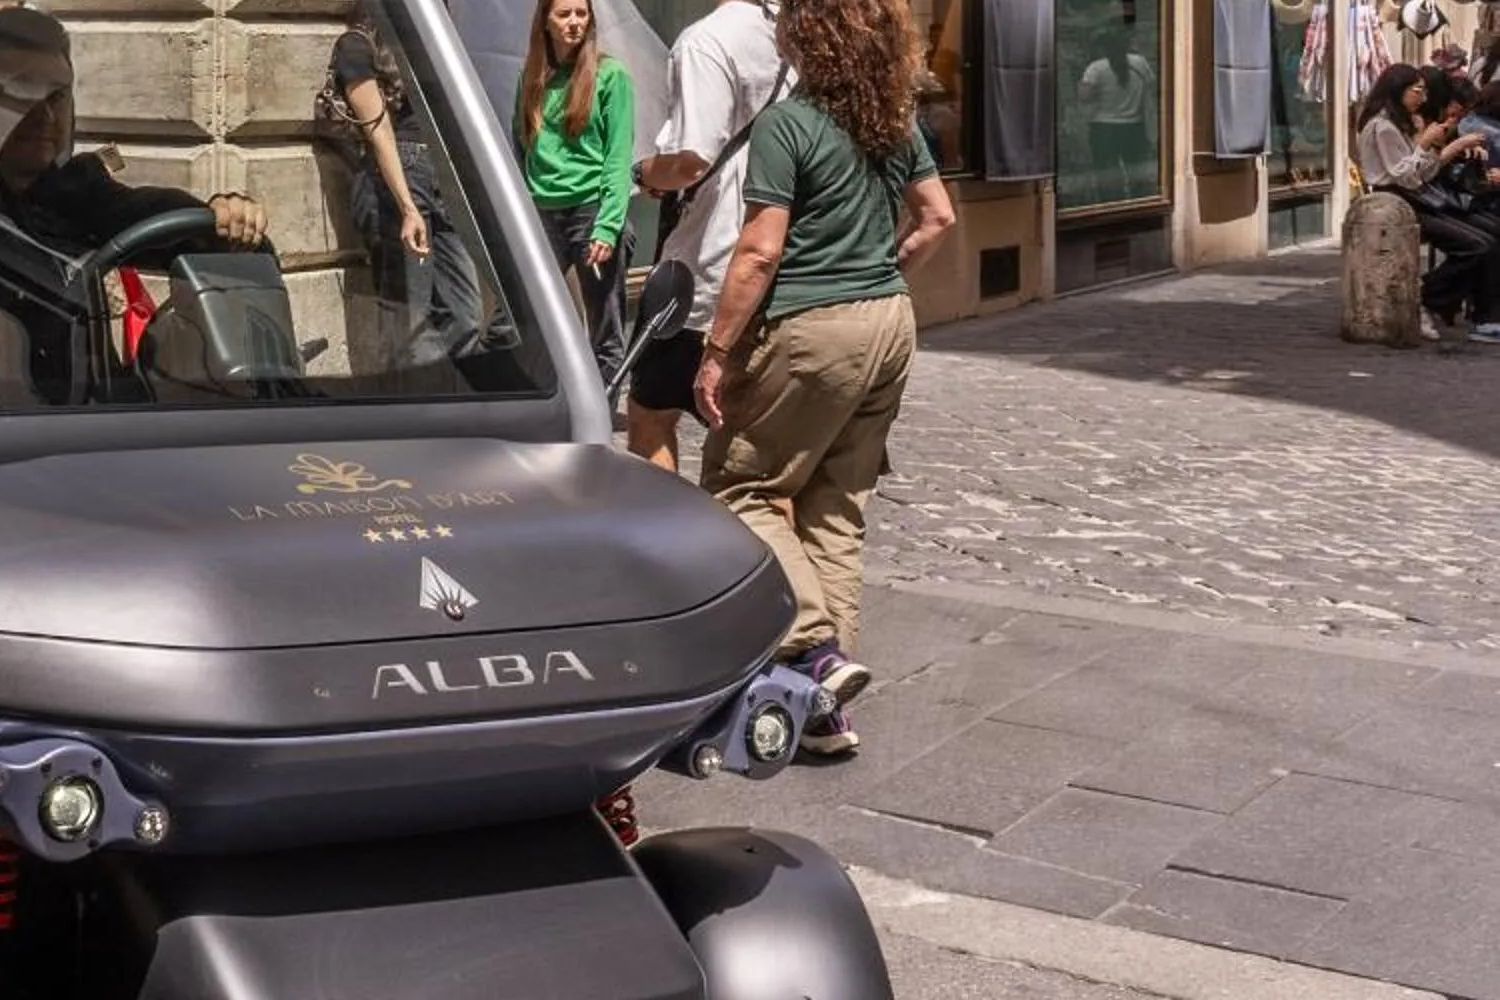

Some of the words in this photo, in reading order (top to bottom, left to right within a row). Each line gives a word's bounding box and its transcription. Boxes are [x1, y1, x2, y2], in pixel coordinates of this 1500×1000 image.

[228, 503, 279, 521] LA
[284, 496, 426, 518] MAISON
[426, 489, 517, 509] D'ART
[372, 650, 595, 699] ALBA
